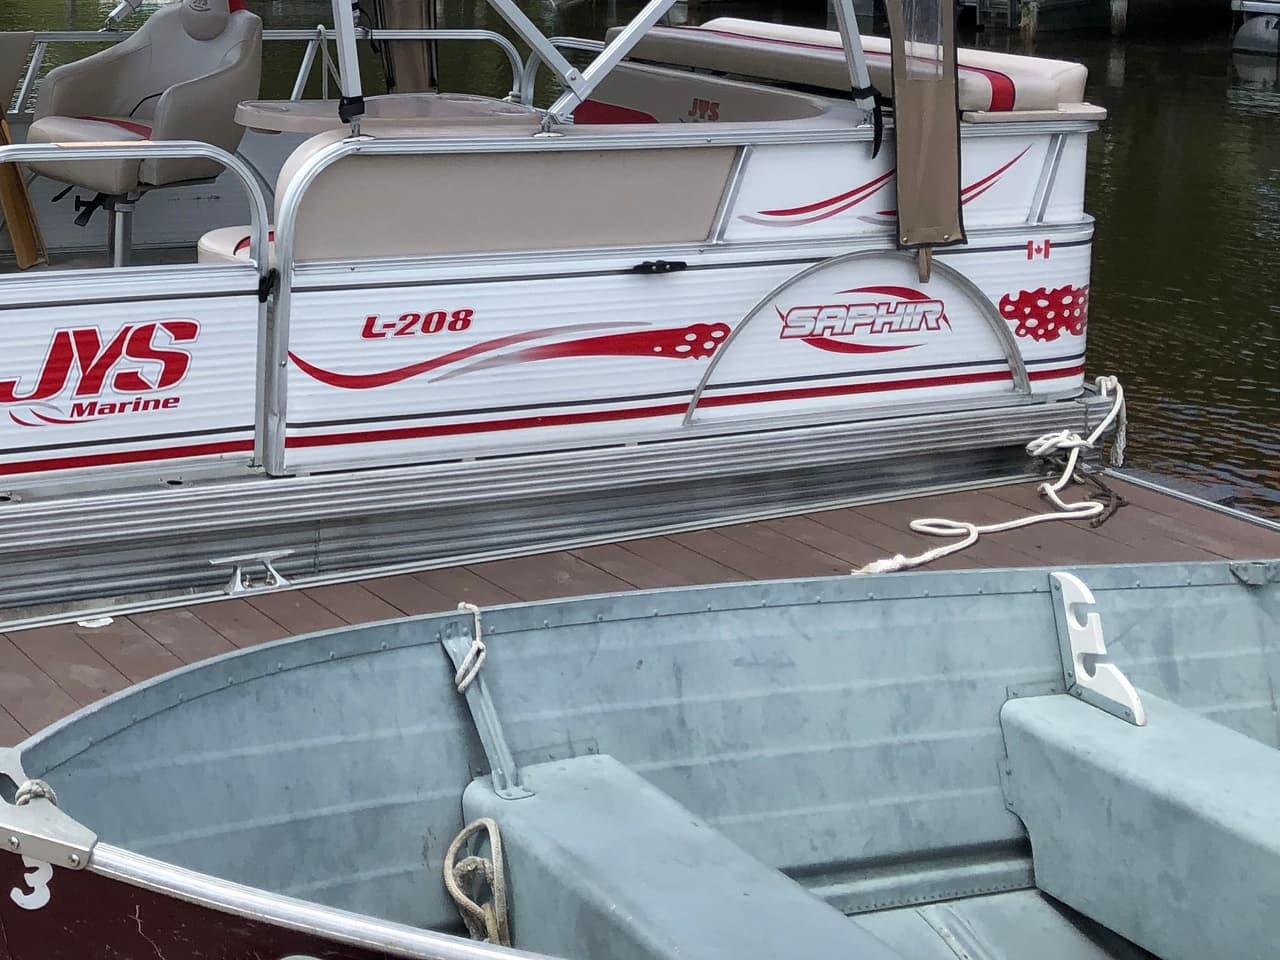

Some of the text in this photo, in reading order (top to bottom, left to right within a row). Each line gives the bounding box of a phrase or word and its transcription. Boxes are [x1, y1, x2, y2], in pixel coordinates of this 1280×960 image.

[688, 97, 720, 121] JYS
[361, 308, 474, 339] L-208
[779, 298, 945, 339] SAPHIR
[70, 396, 181, 418] Marine
[9, 854, 54, 911] 3
